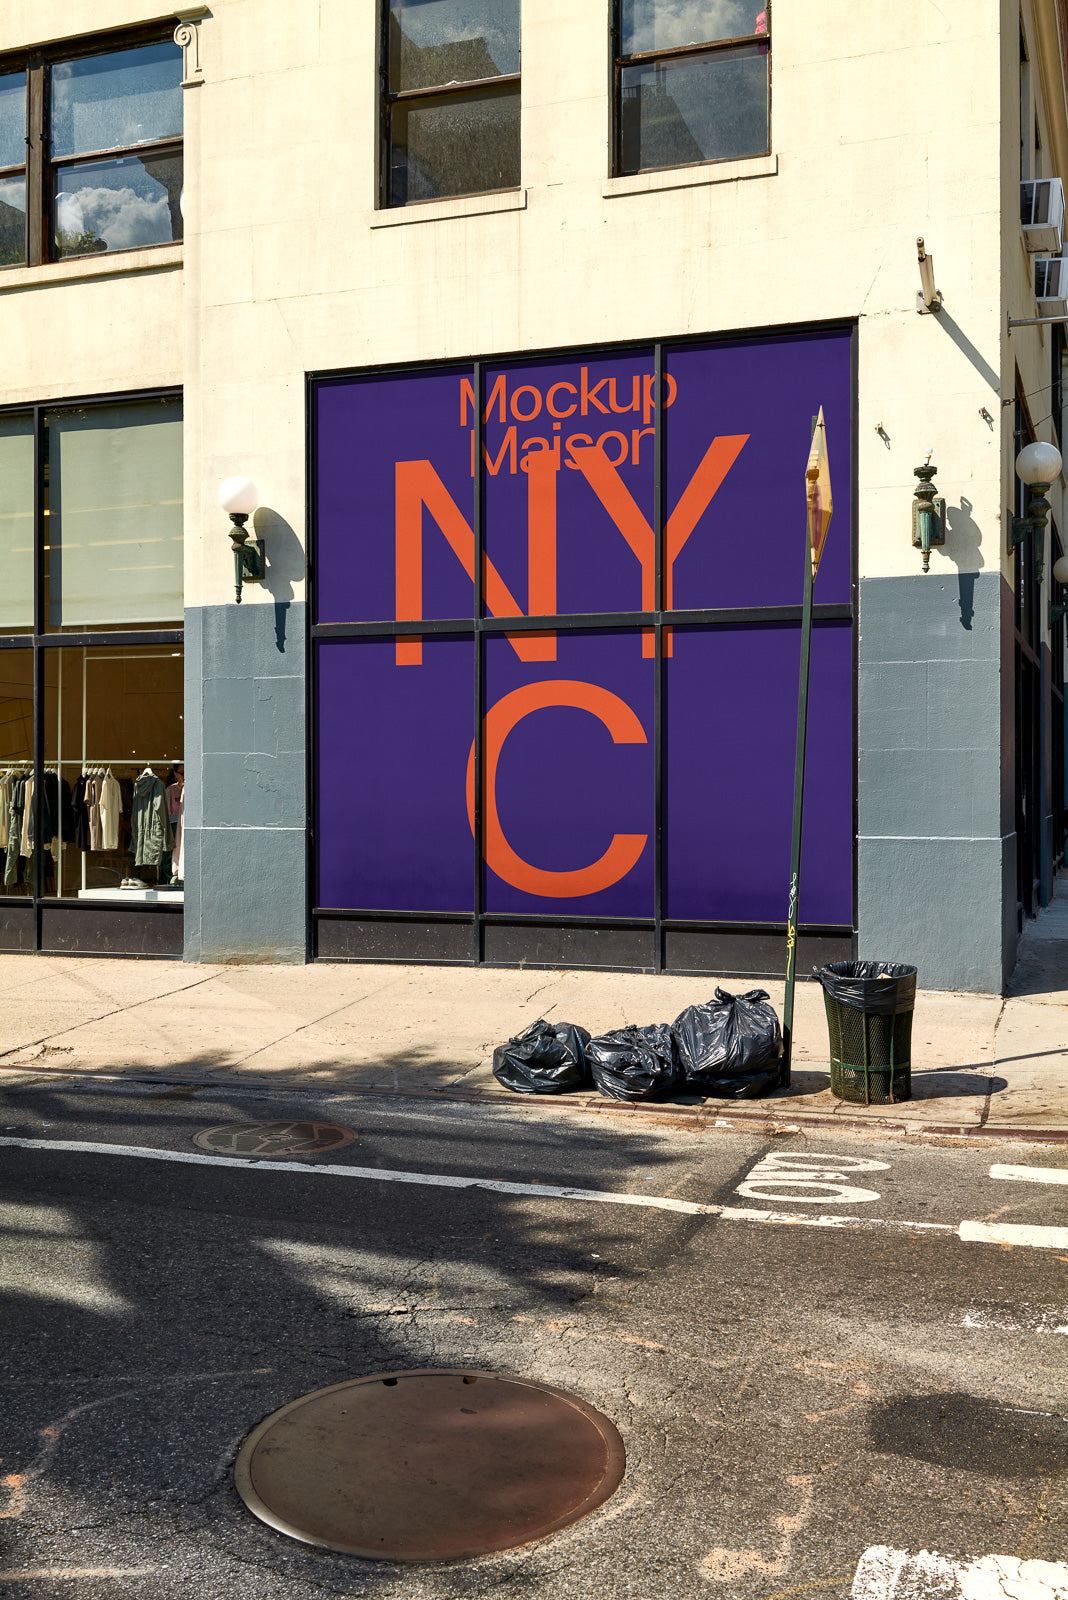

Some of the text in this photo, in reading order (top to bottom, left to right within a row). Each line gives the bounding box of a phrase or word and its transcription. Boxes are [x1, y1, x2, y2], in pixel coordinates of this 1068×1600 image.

[460, 367, 677, 426] Mockup
[395, 434, 750, 666] NY
[466, 680, 648, 898] C
